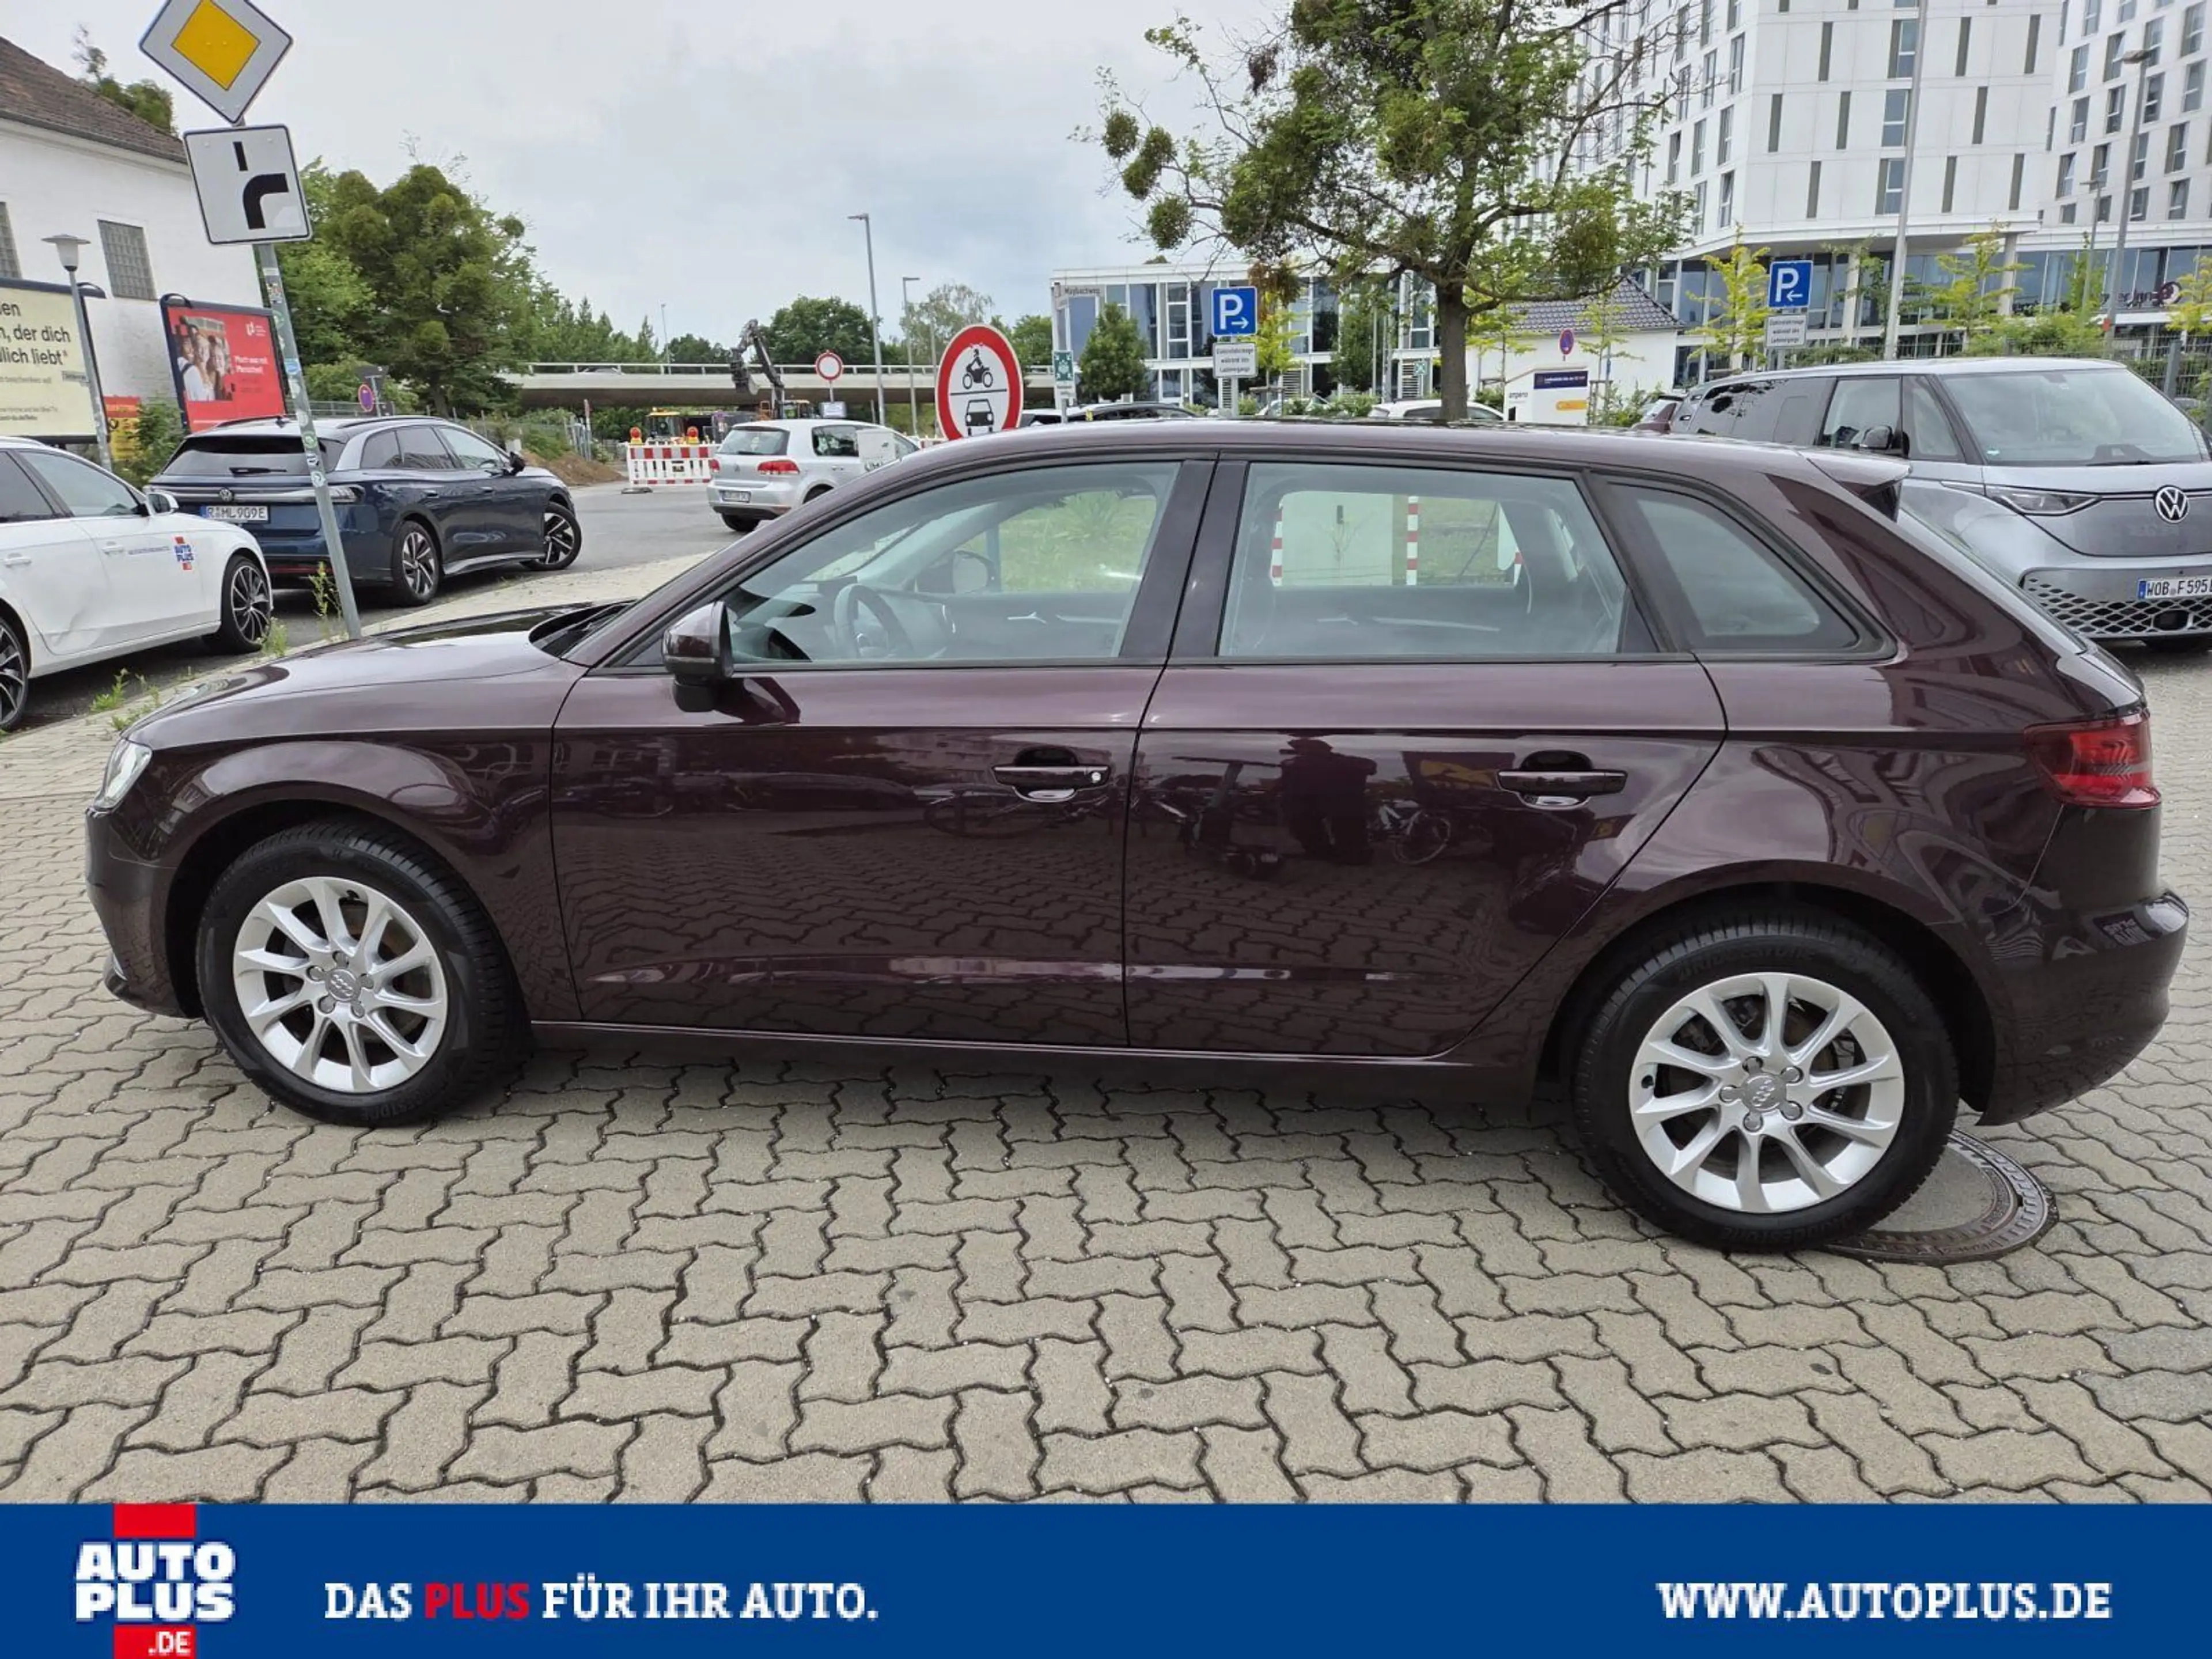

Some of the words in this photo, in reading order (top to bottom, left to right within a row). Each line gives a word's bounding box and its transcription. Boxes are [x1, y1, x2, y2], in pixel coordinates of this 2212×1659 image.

[1775, 267, 1800, 302] P
[0, 302, 21, 316] en
[1219, 294, 1243, 330] P
[13, 324, 38, 341] der
[41, 326, 71, 342] dich
[2147, 581, 2171, 596] WOB
[2177, 580, 2186, 594] F
